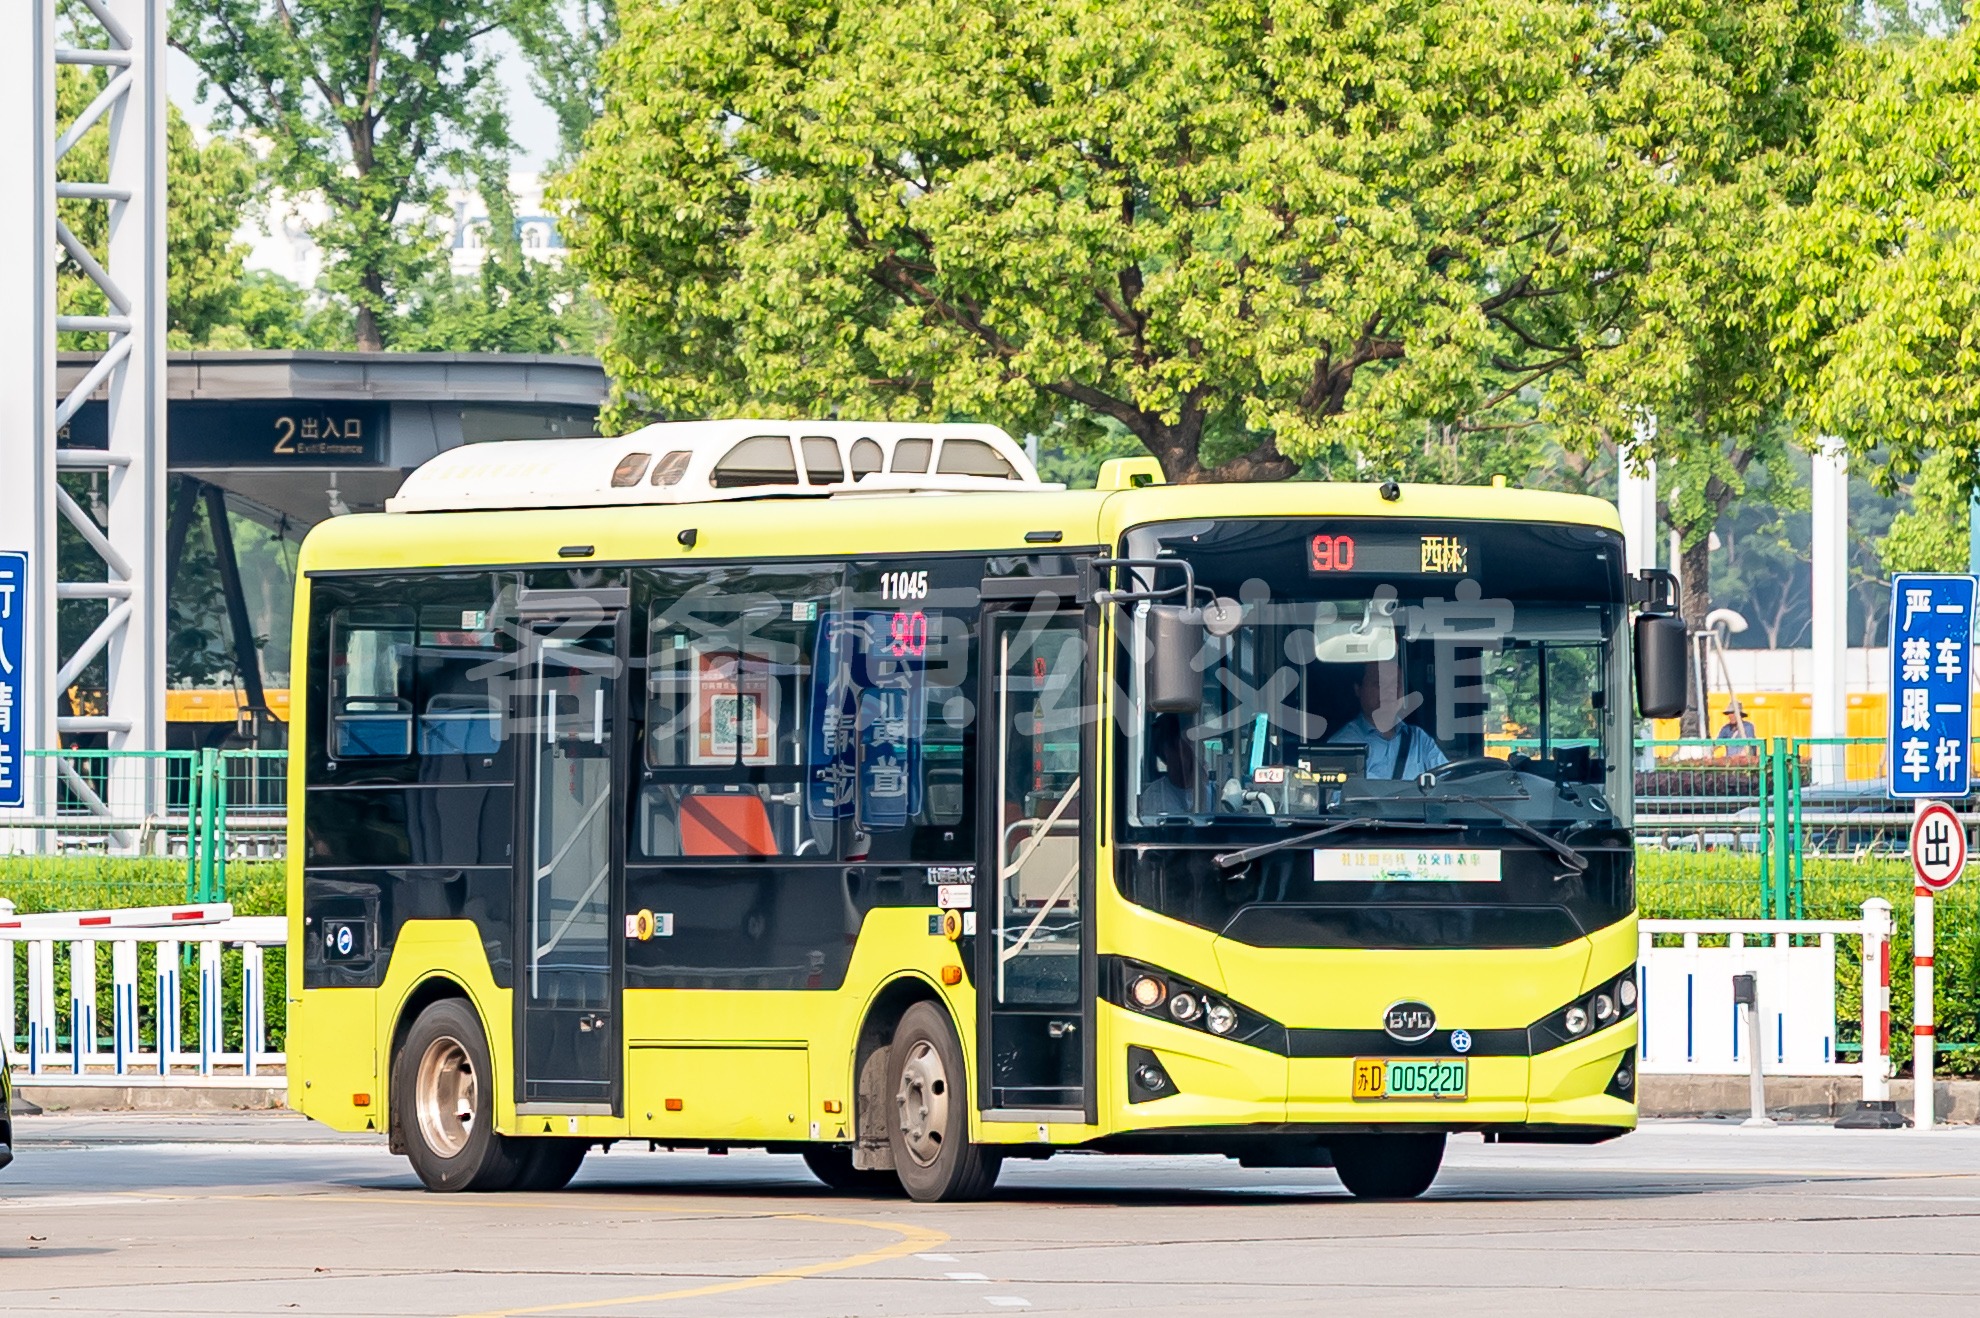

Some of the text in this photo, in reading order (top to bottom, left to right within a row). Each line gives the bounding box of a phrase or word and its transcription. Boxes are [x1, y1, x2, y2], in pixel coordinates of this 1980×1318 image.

[273, 417, 296, 454] 2
[301, 417, 362, 439] 出入口
[1312, 535, 1354, 571] 90
[1420, 536, 1468, 573] 西林
[880, 571, 928, 600] 11045
[891, 611, 927, 657] 90
[1901, 588, 1933, 783] 严禁跟车
[1935, 604, 1964, 783] 一车一杆
[1925, 820, 1950, 868] 出
[1389, 1011, 1431, 1029] BYD
